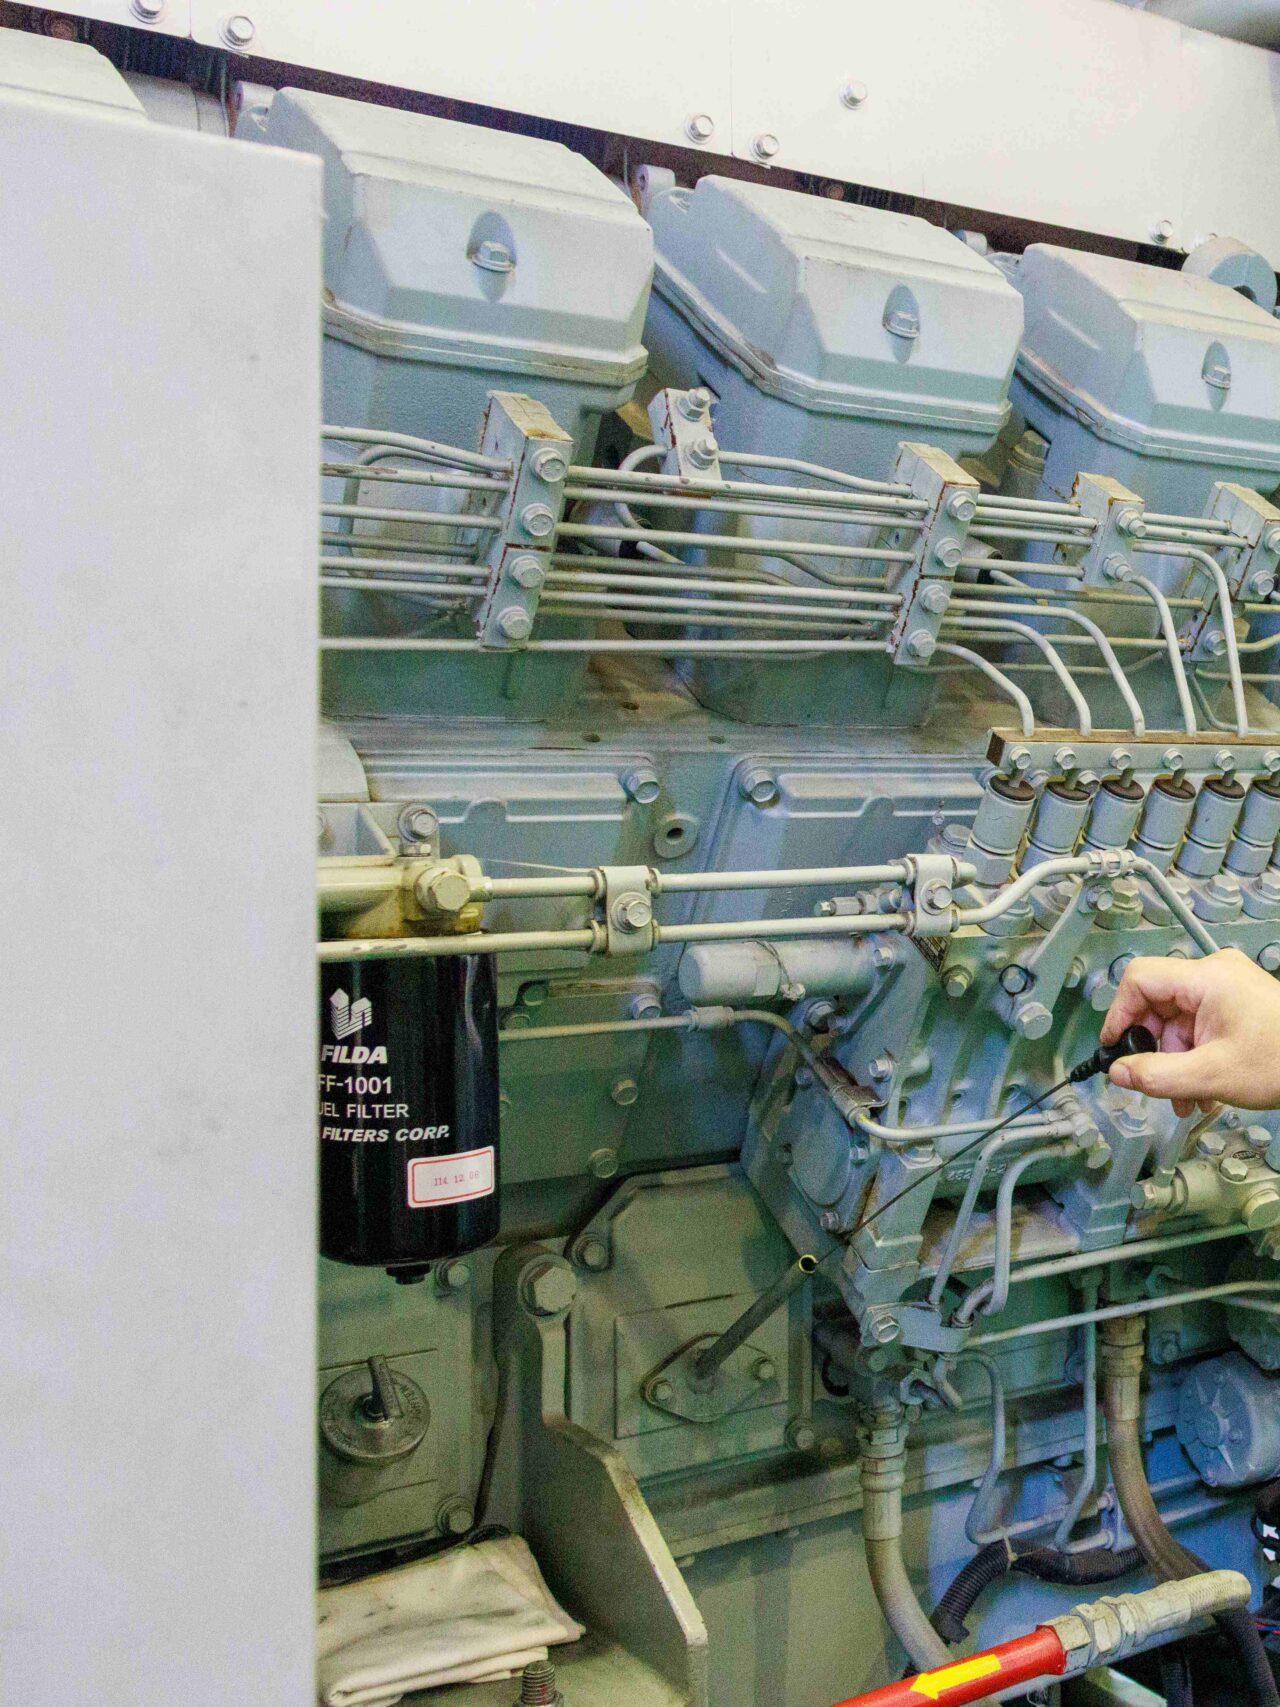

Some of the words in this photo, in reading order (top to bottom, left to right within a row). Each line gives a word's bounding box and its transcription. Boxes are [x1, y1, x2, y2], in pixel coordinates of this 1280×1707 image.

[322, 1044, 388, 1064] FILDA
[346, 1103, 410, 1119] FILTER
[322, 1126, 390, 1142] FILTERS
[395, 1125, 450, 1141] CORP.
